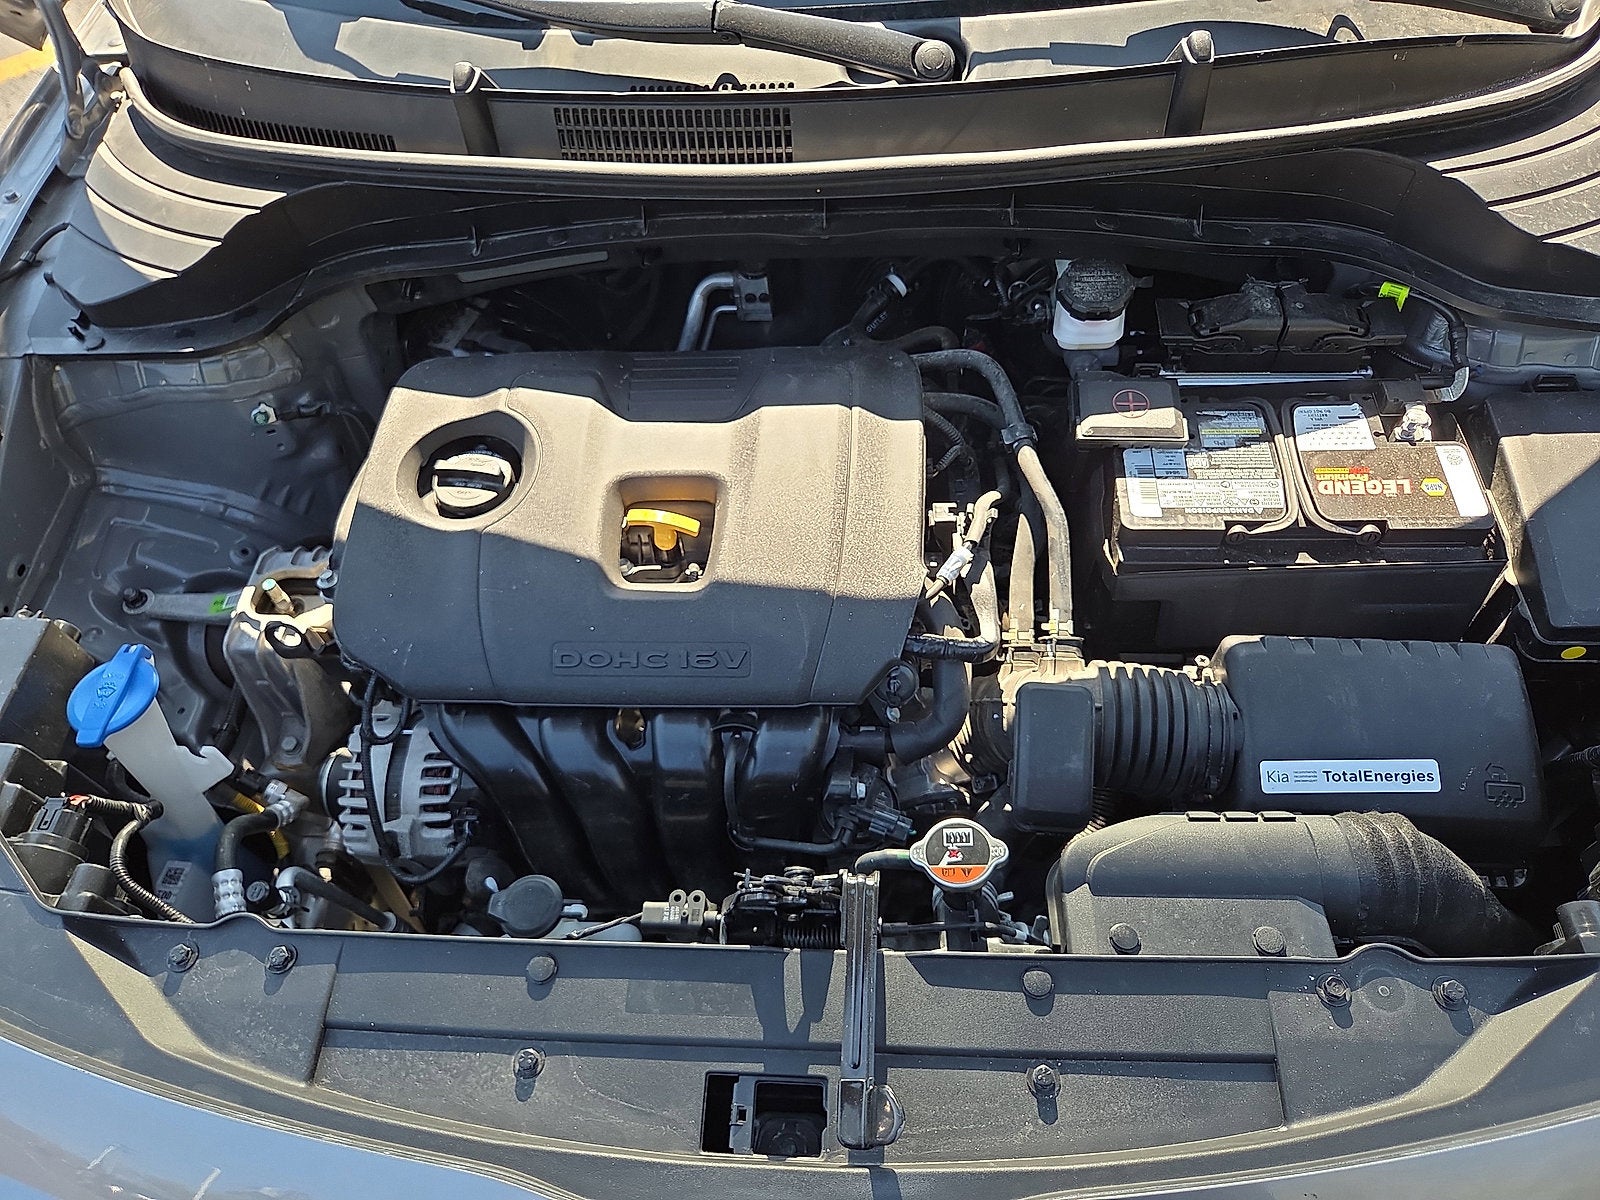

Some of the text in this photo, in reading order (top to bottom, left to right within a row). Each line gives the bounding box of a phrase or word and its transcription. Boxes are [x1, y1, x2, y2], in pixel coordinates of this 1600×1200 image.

[1315, 473, 1369, 481] Premium
[1317, 479, 1412, 495] LEGEND
[1425, 483, 1443, 491] NAPA
[555, 650, 749, 669] DOHC 16V
[1266, 770, 1290, 783] Kia
[1322, 770, 1435, 785] TotalEnergies
